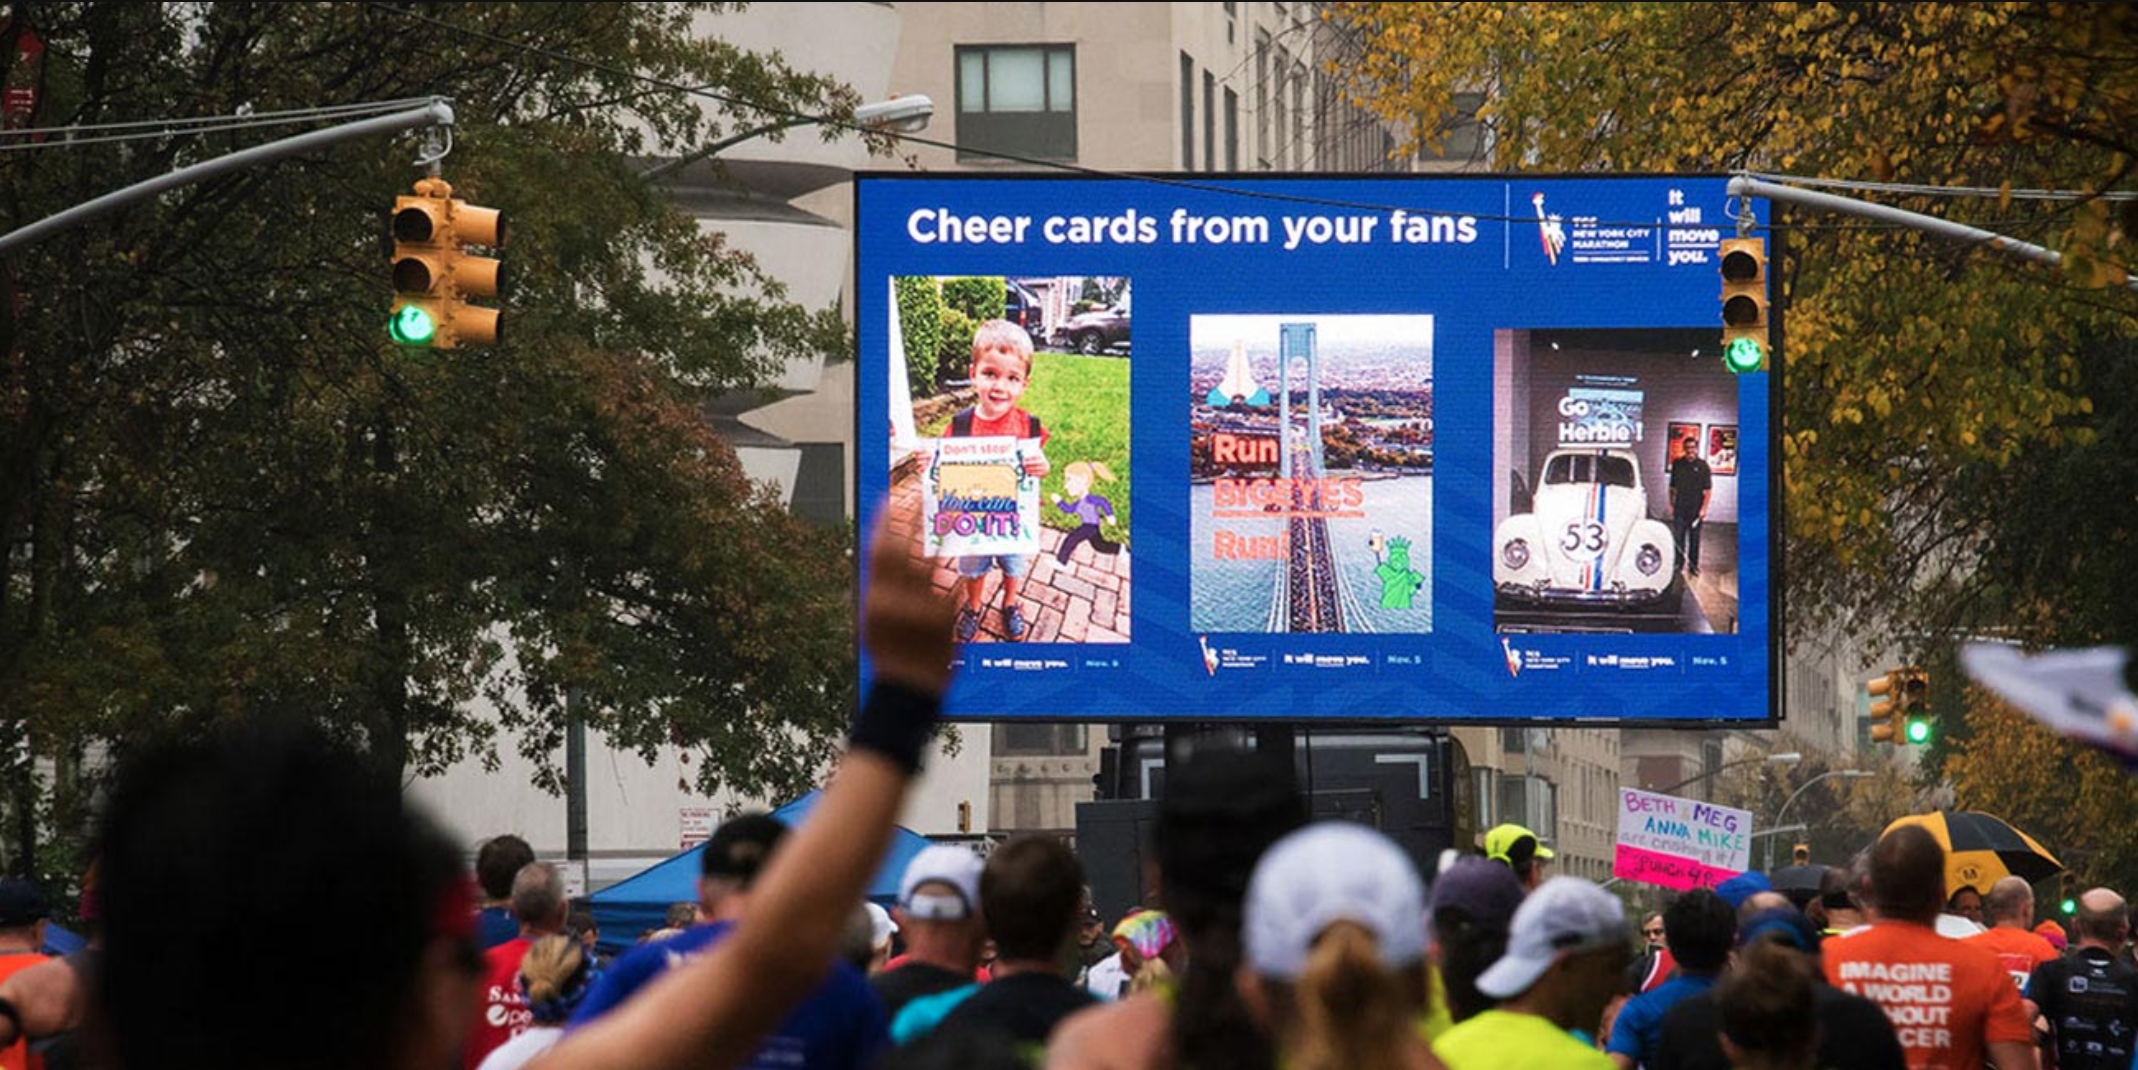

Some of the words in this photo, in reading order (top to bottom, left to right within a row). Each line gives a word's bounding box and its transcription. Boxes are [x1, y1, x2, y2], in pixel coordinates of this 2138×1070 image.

[1669, 190, 1684, 205] It
[1669, 208, 1701, 224] will
[907, 208, 1031, 243] Cheer
[1043, 208, 1158, 243] cards
[1170, 208, 1268, 243] from
[1282, 216, 1376, 250] your
[1390, 208, 1478, 243] fans
[1572, 229, 1596, 238] NEW
[1598, 229, 1625, 238] YORK
[1626, 229, 1650, 238] CITY
[1669, 229, 1720, 243] move
[1572, 240, 1630, 249] MARATHON
[1668, 250, 1708, 266] you.
[1558, 397, 1590, 417] Go
[1558, 422, 1632, 442] Herbie
[1213, 433, 1279, 463] Run
[940, 488, 973, 511] You
[977, 496, 1015, 511] can
[934, 513, 976, 537] DO
[984, 513, 1020, 537] IT!
[1213, 531, 1290, 560] Run!
[1565, 524, 1605, 552] 53
[1625, 792, 1675, 814] BETH
[1693, 803, 1737, 834] MEG
[1644, 816, 1691, 840] ANNA
[1698, 828, 1744, 850] MIKE
[1839, 961, 1952, 982] IMAGINE
[1864, 983, 1952, 1003] WORLD
